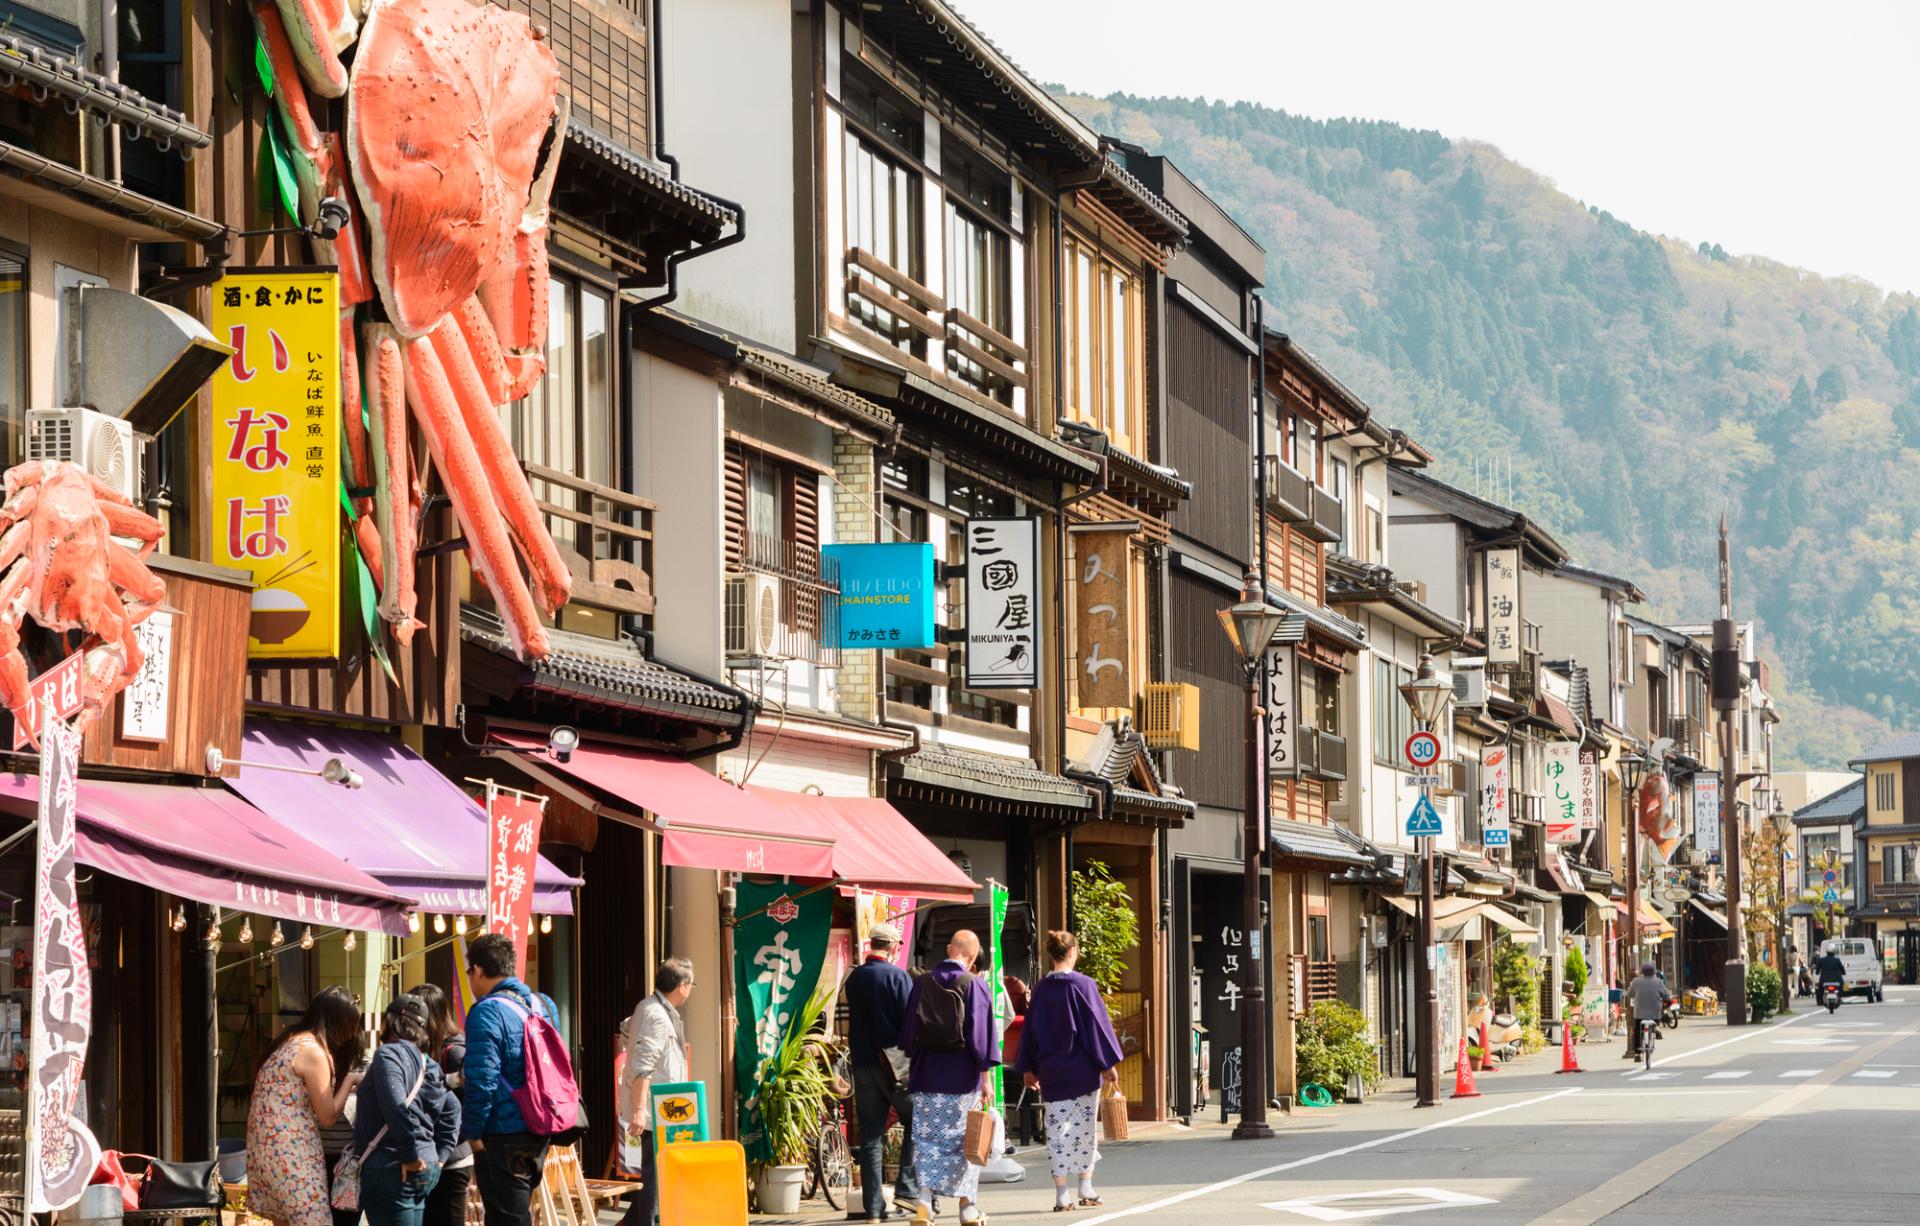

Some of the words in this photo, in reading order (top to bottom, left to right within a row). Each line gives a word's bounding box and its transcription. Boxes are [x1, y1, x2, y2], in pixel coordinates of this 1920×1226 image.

[223, 286, 324, 308] 酒・食・かに
[227, 323, 290, 560] いなば
[305, 350, 325, 479] いなば鮮魚直営
[835, 577, 922, 593] HISEIDO
[971, 526, 1032, 631] 三國屋
[848, 627, 902, 641] かみさき
[970, 634, 1015, 644] MIKUNIYA
[1083, 553, 1124, 684] みつわ
[1492, 595, 1514, 650] 油屋
[1268, 652, 1288, 763] よしはる
[1413, 741, 1434, 758] 30
[1580, 751, 1594, 765] 酒
[1408, 776, 1440, 786] 区域内
[1546, 760, 1576, 819] ゆしま
[1218, 926, 1244, 1012] 但馬牛
